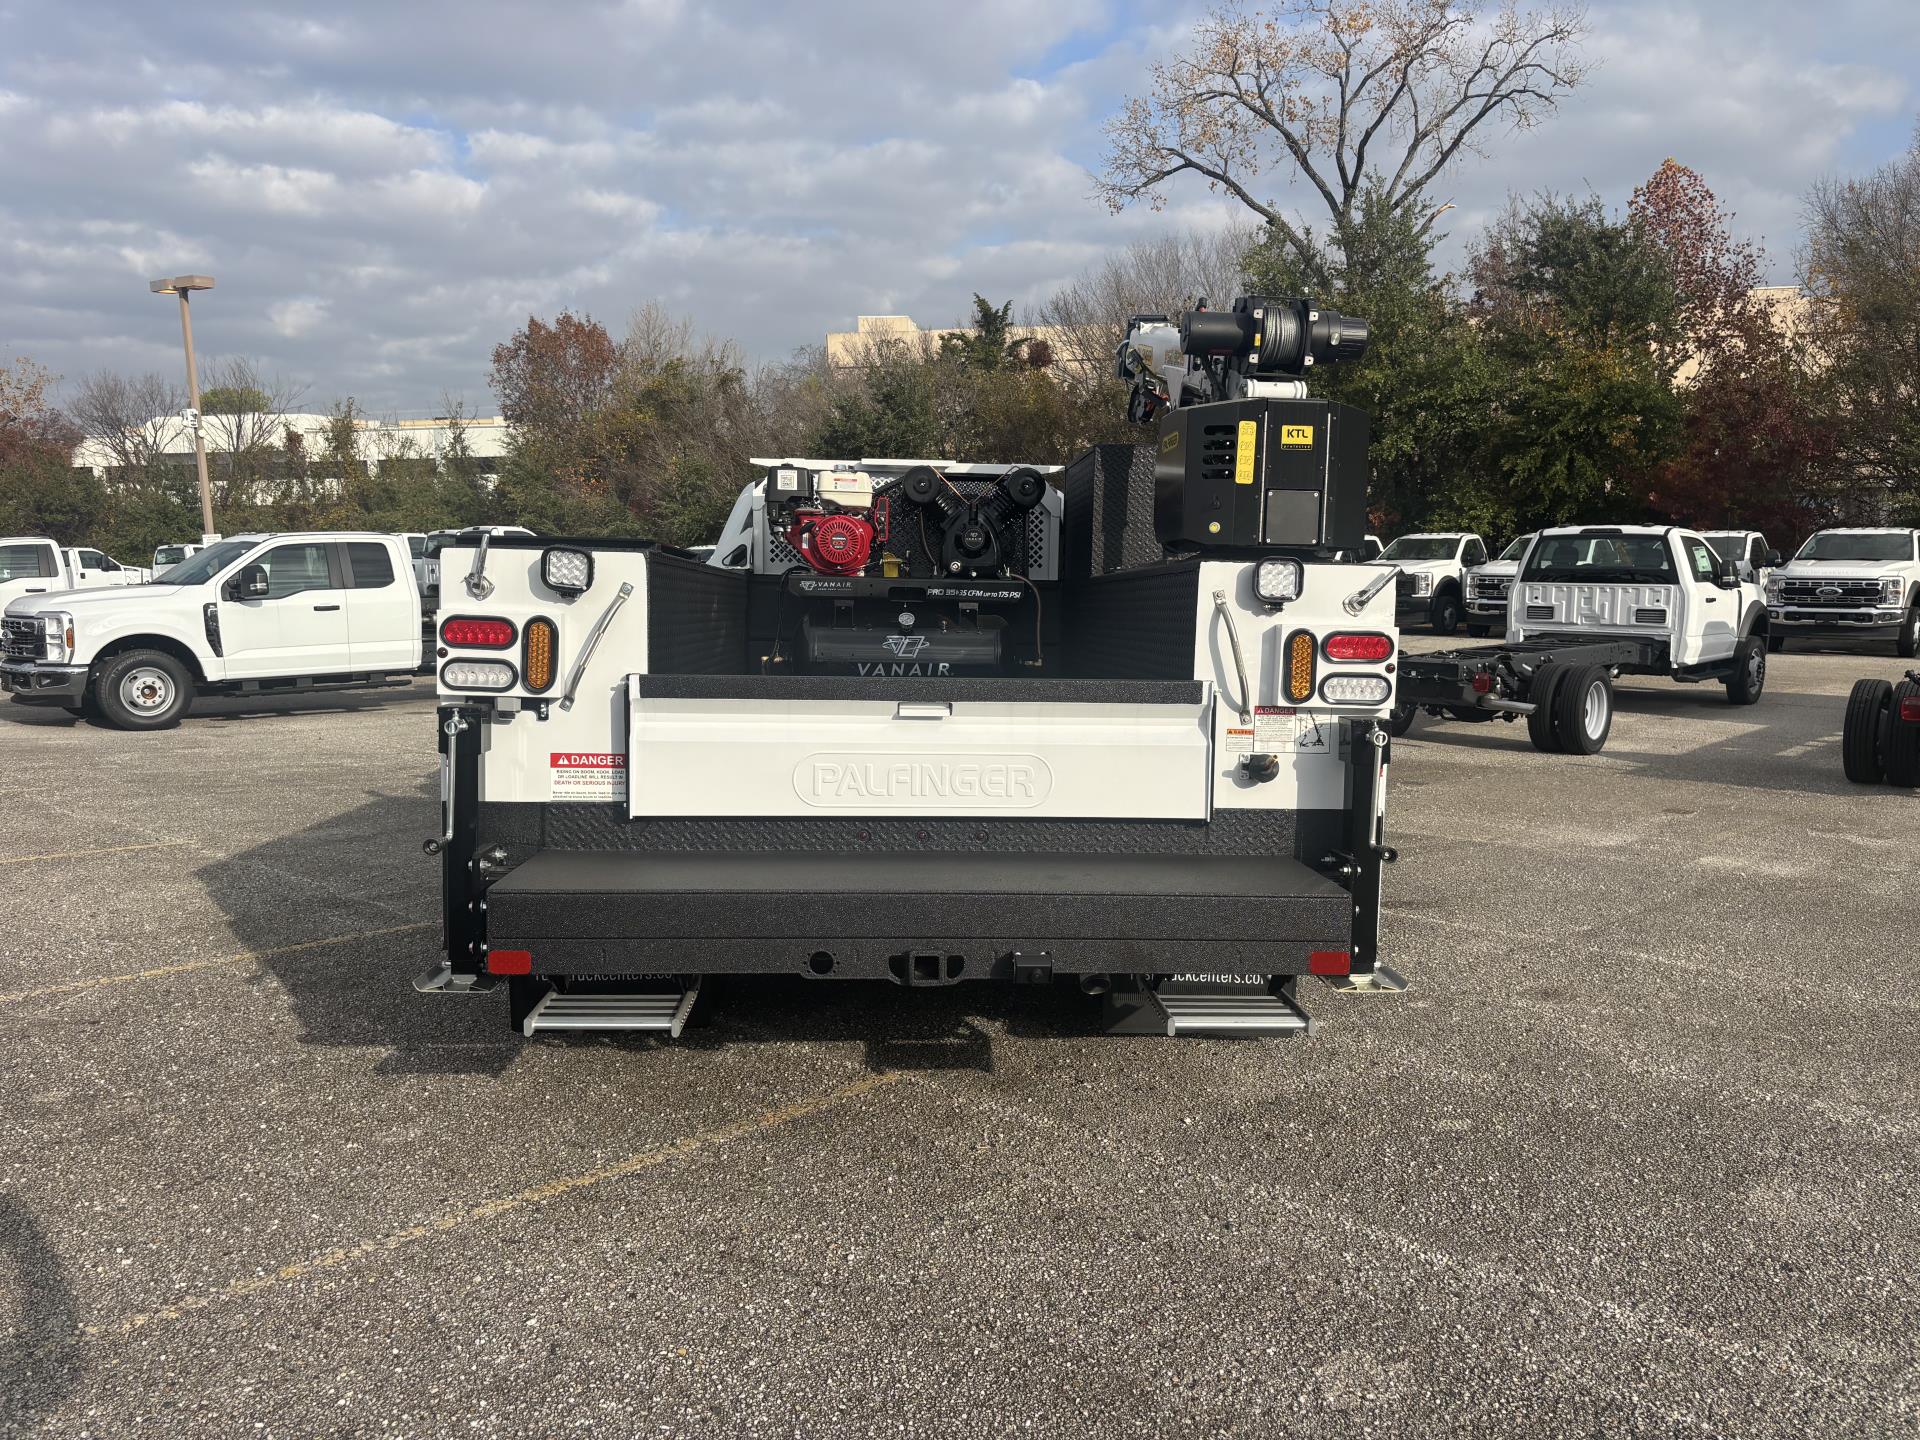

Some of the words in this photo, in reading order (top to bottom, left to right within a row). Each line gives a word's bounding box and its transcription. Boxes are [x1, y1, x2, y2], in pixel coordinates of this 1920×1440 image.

[1287, 428, 1308, 439] KTL
[927, 588, 944, 596] PRO
[967, 589, 983, 597] CFM
[1009, 591, 1021, 599] PSI
[857, 662, 950, 677] VANAIR
[571, 755, 624, 766] DANGER
[812, 762, 1034, 798] PALFINGER
